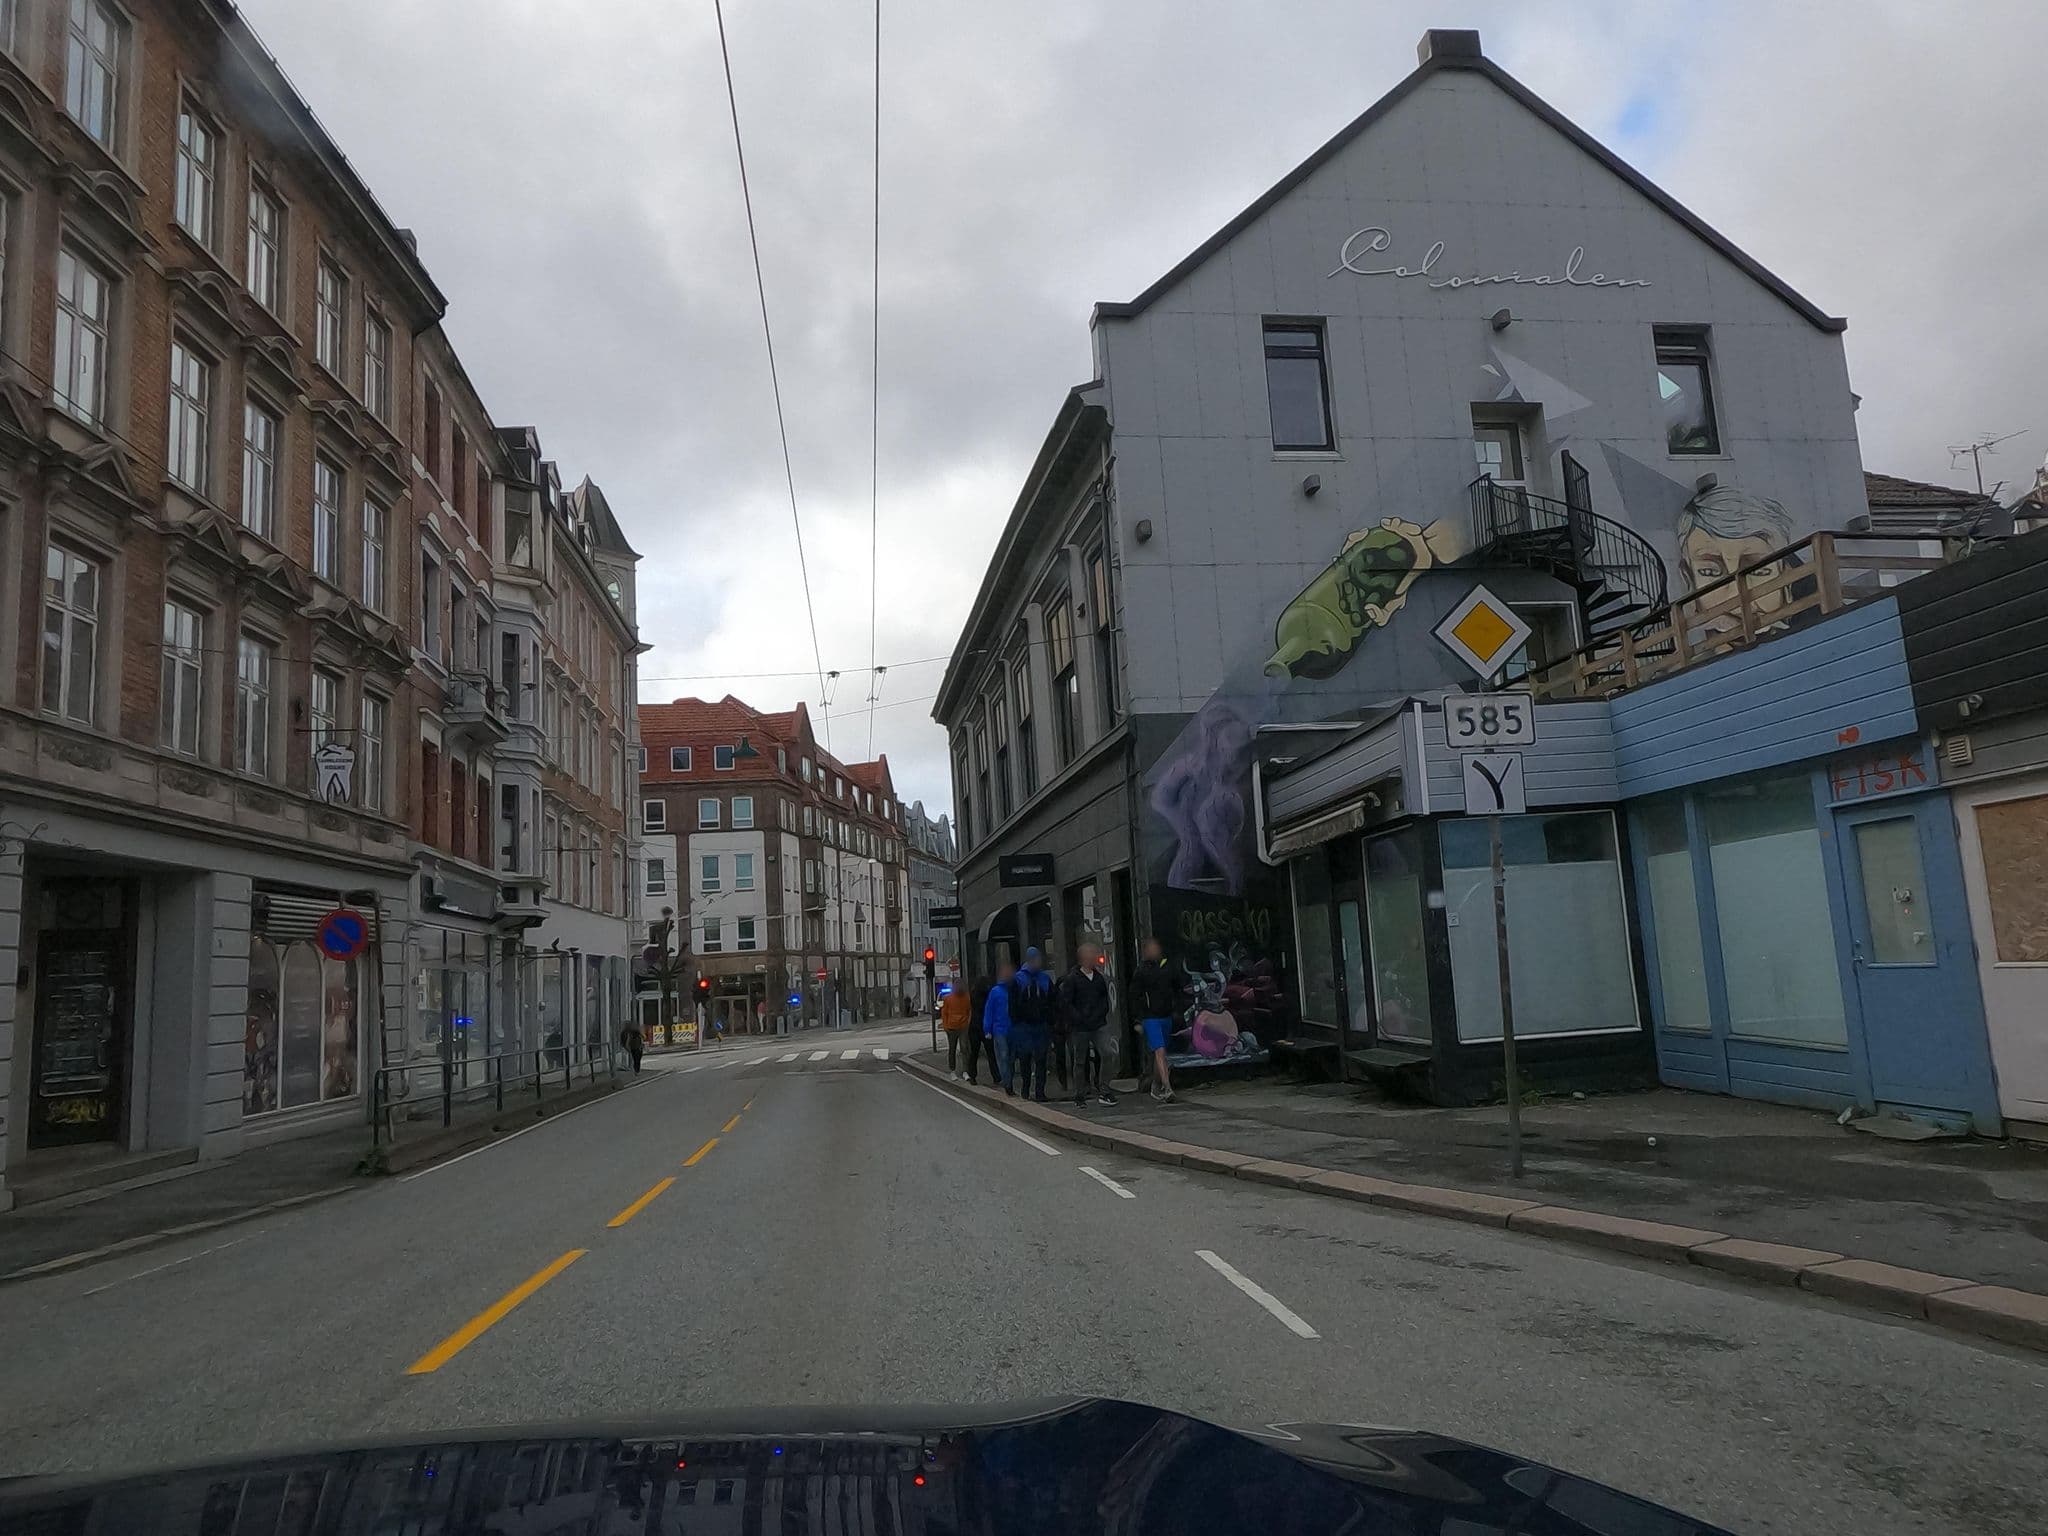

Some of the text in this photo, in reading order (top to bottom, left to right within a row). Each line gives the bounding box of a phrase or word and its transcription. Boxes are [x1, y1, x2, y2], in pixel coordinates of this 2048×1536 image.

[1328, 226, 1653, 288] Colonialen
[1457, 704, 1523, 736] 585
[1832, 753, 1927, 800] FISK
